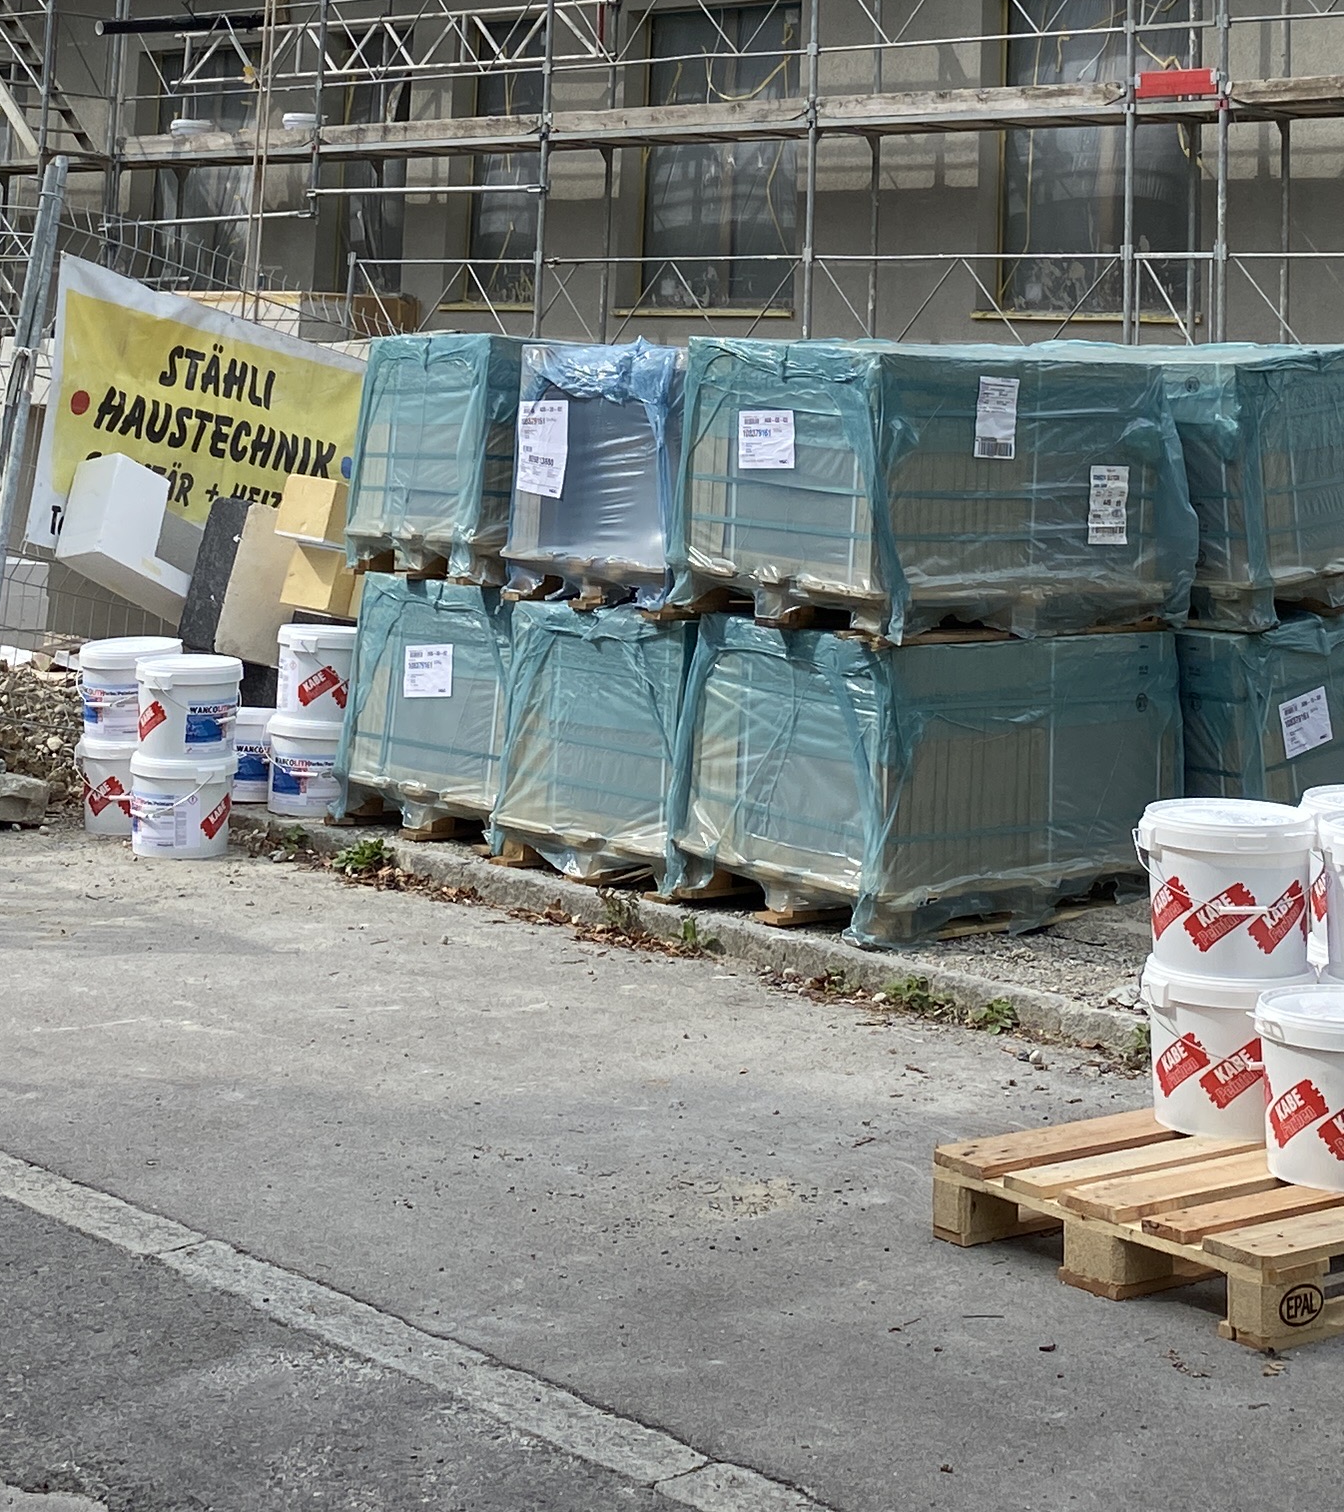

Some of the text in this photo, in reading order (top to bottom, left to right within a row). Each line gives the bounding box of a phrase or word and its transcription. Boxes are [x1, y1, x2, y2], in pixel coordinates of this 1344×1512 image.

[159, 343, 276, 410] STÄHLI
[93, 386, 337, 478] HAUSTECHNIK
[302, 671, 327, 693] KABE
[1160, 1041, 1189, 1073] KABE
[1213, 1048, 1254, 1085] KABE
[1274, 1088, 1305, 1122] KABE
[1286, 1292, 1317, 1320] EPAL
